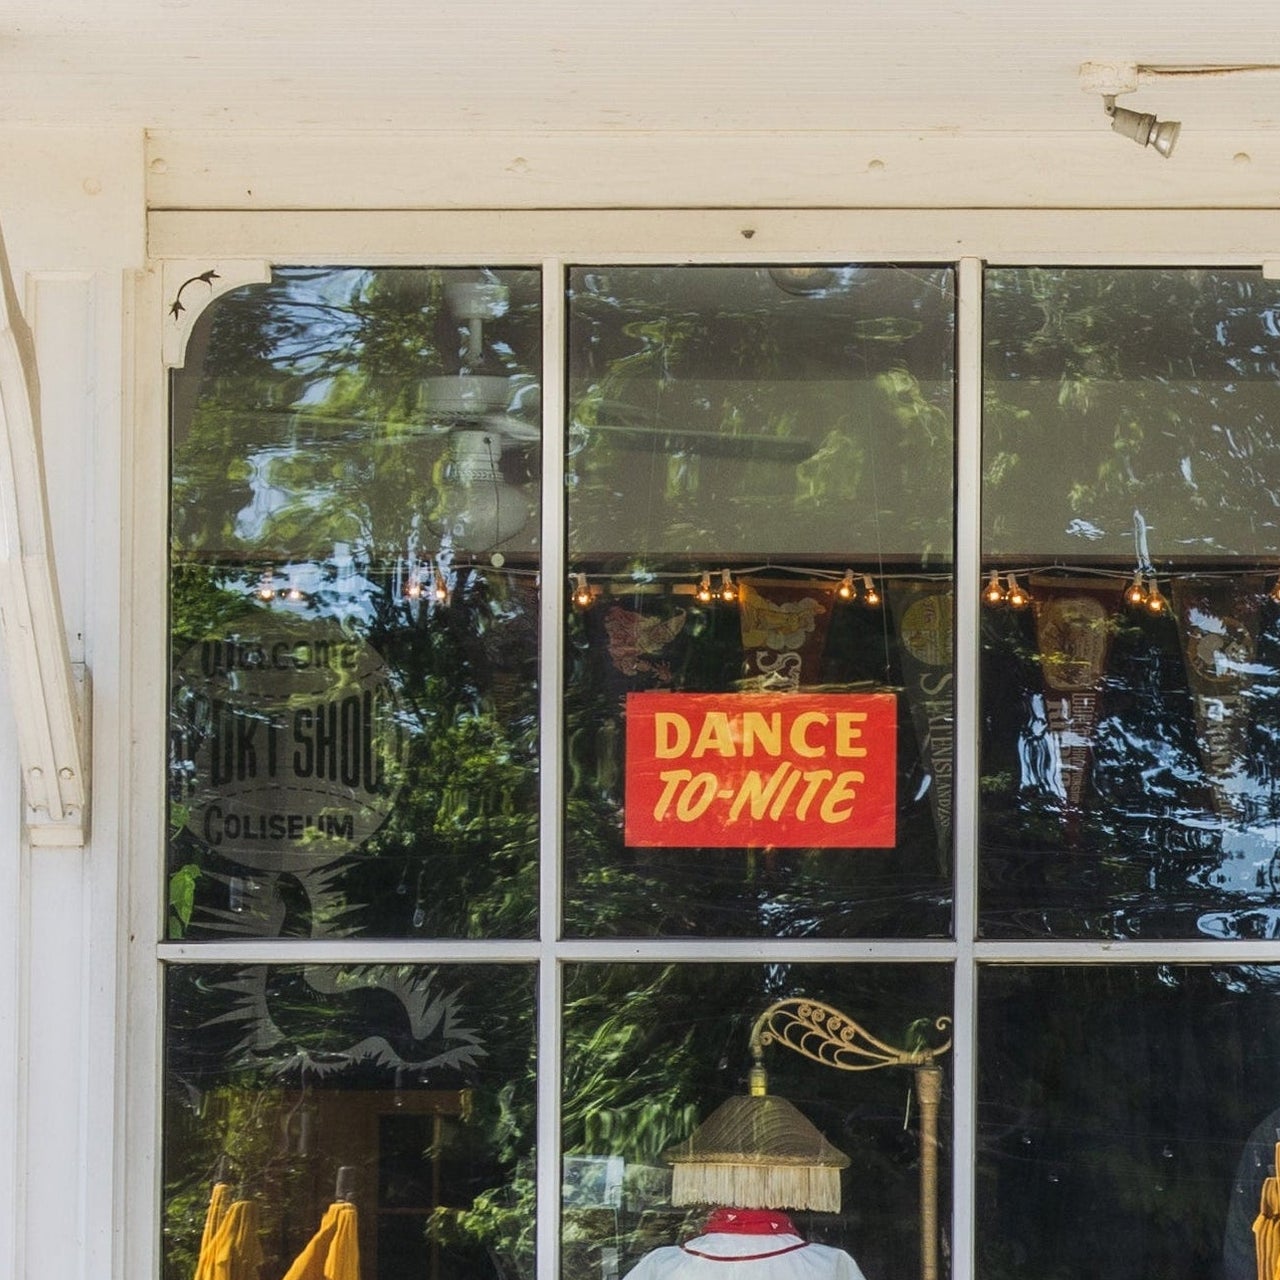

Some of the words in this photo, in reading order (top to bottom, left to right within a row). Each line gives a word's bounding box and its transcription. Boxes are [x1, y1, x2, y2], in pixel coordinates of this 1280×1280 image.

[654, 711, 868, 759] DANCE
[653, 761, 865, 824] TO-NITE
[204, 804, 354, 845] COLISEUM
